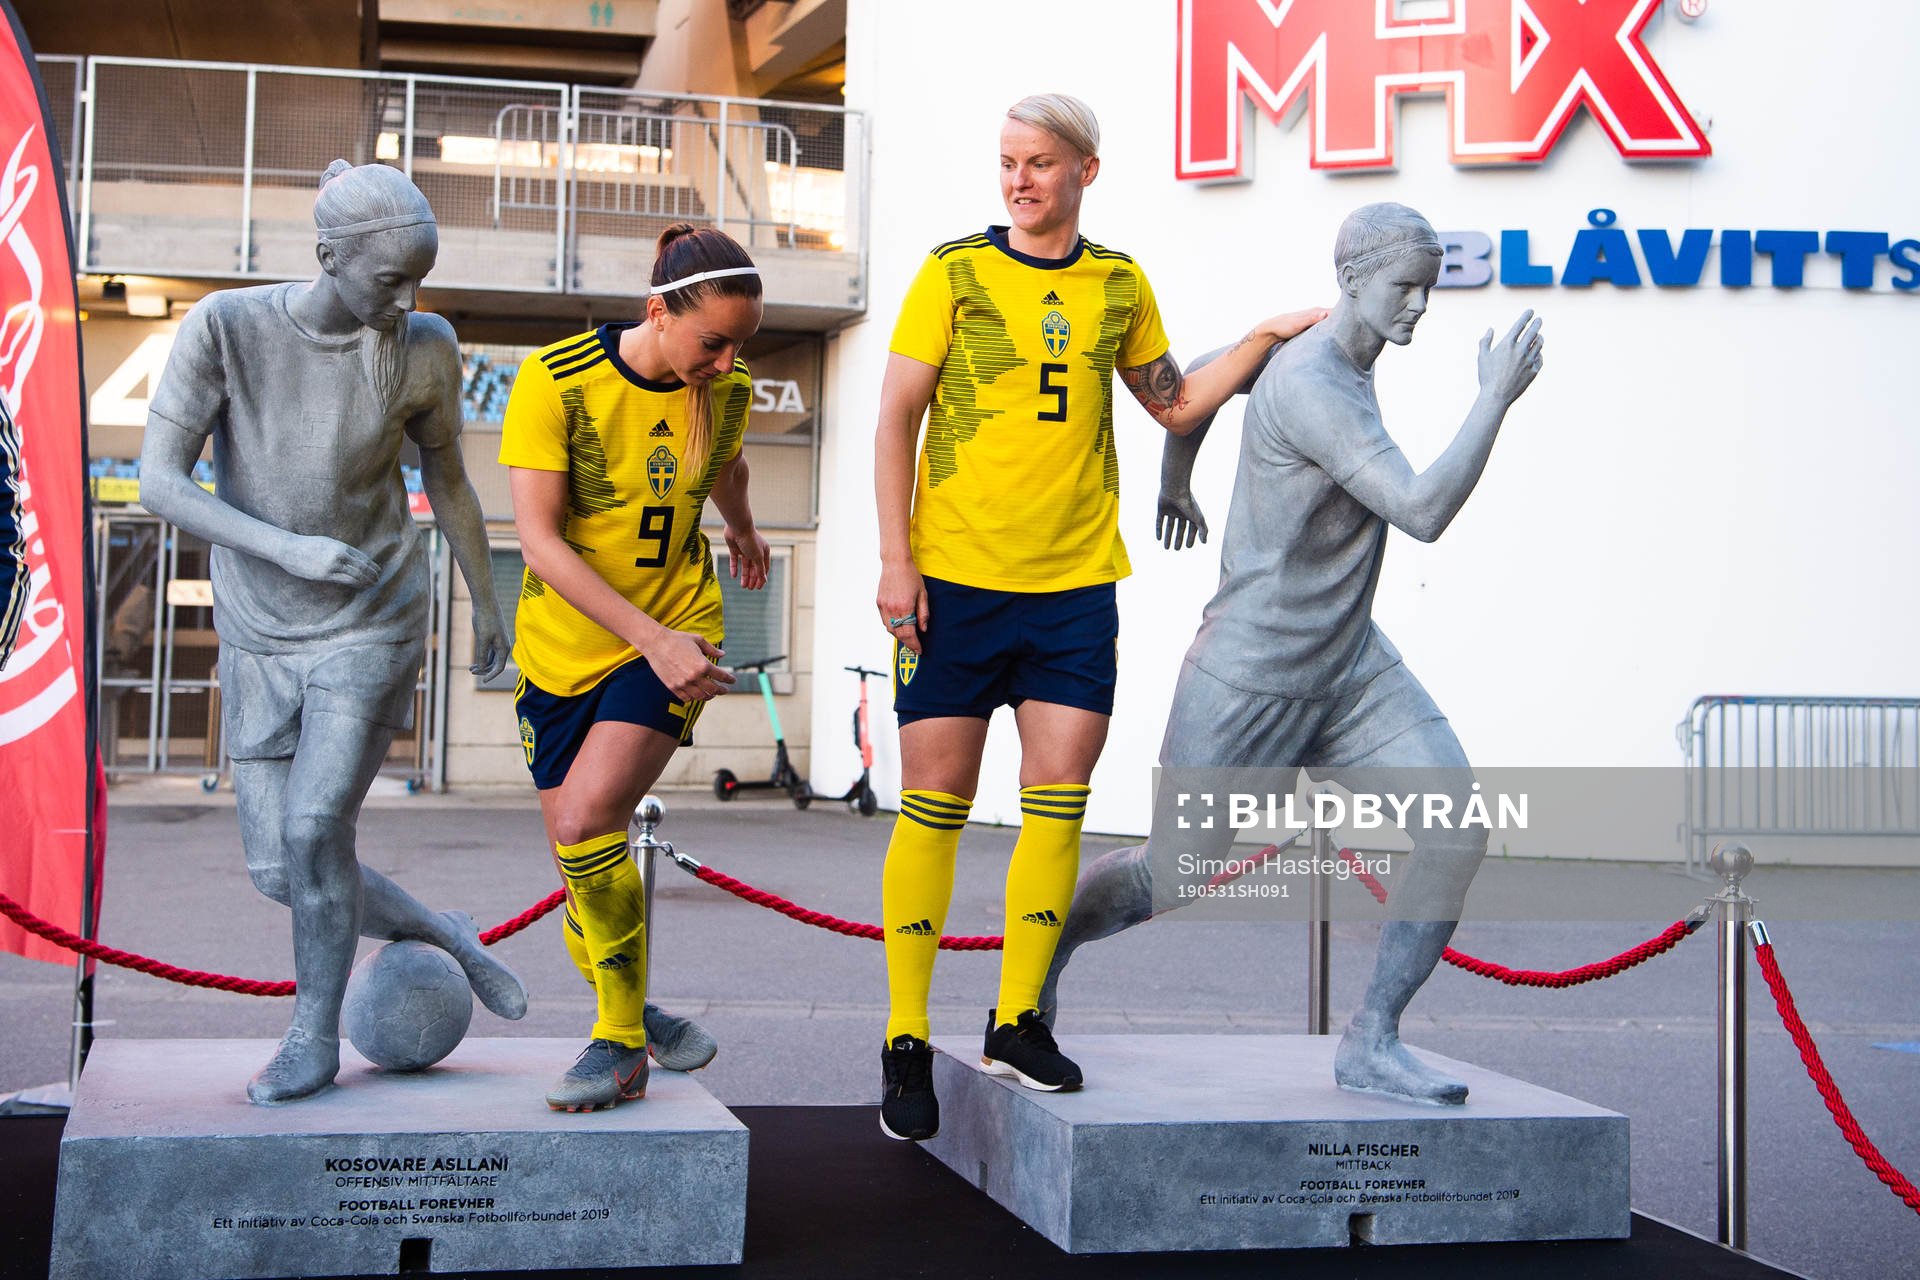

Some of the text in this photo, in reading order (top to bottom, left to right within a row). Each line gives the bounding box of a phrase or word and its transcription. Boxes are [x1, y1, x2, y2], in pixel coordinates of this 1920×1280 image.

[1037, 362, 1069, 423] 5
[648, 430, 675, 438] adidas
[635, 505, 675, 568] 9
[1022, 914, 1062, 927] adidas
[896, 927, 936, 937] adidas
[1308, 1143, 1420, 1157] NILLA FISCHER
[325, 1156, 509, 1172] KOSOVARE ASLLANI
[1335, 1159, 1392, 1171] MITTBACK
[335, 1174, 498, 1188] OFFENSIV MITTFÄLTARE
[1300, 1179, 1426, 1191] FOOTBALL FOREVHER
[1200, 1188, 1521, 1205] Ett initiativ av Coca-Cola och Svenska Fotbollförbundet 2019
[338, 1197, 495, 1211] FOOTBALL FOREVHER
[213, 1208, 610, 1229] Ett initiativ av Coca-Cola och Svenska Fotbollförbundet 2019
